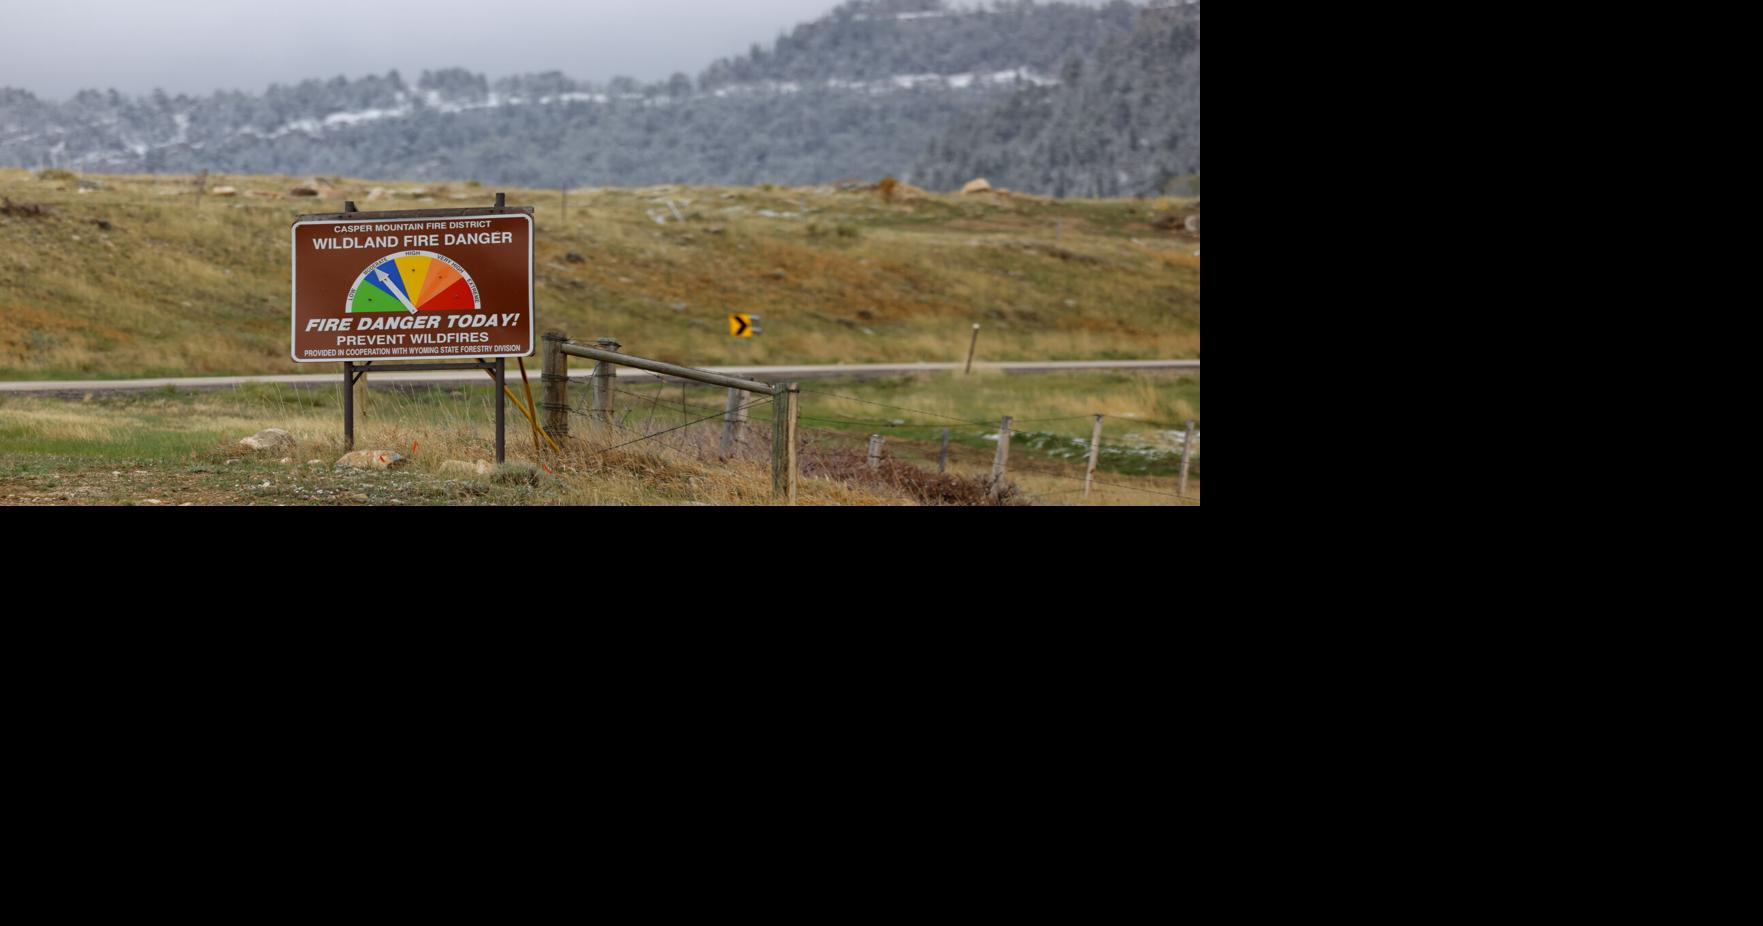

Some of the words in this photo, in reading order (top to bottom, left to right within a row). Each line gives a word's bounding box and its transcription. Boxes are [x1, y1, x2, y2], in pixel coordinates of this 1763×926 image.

[334, 224, 373, 233] CASPER
[375, 223, 424, 232] MOUNTAIN
[426, 222, 447, 230] FIRE
[449, 220, 492, 229] DISTRICT
[312, 236, 399, 250] WILDLAND
[403, 234, 440, 247] FIRE
[444, 232, 512, 246] DANGER
[363, 257, 388, 275] MODERATE
[437, 254, 452, 264] VERY
[451, 262, 465, 273] HIGH
[347, 288, 356, 301] LOW
[467, 278, 480, 303] EXTREME
[305, 318, 353, 332] FIRE
[357, 315, 441, 331] DANGER
[447, 313, 520, 328] TODAY!
[336, 334, 405, 346] PREVENT
[410, 332, 489, 344] WILDFIRES
[304, 349, 337, 357] PROVIDED
[345, 348, 390, 356] COOPERATION
[391, 347, 408, 355] WITH
[409, 346, 439, 354] WYOMING
[460, 345, 492, 353] FORESTRY
[494, 344, 521, 352] DIVISION
